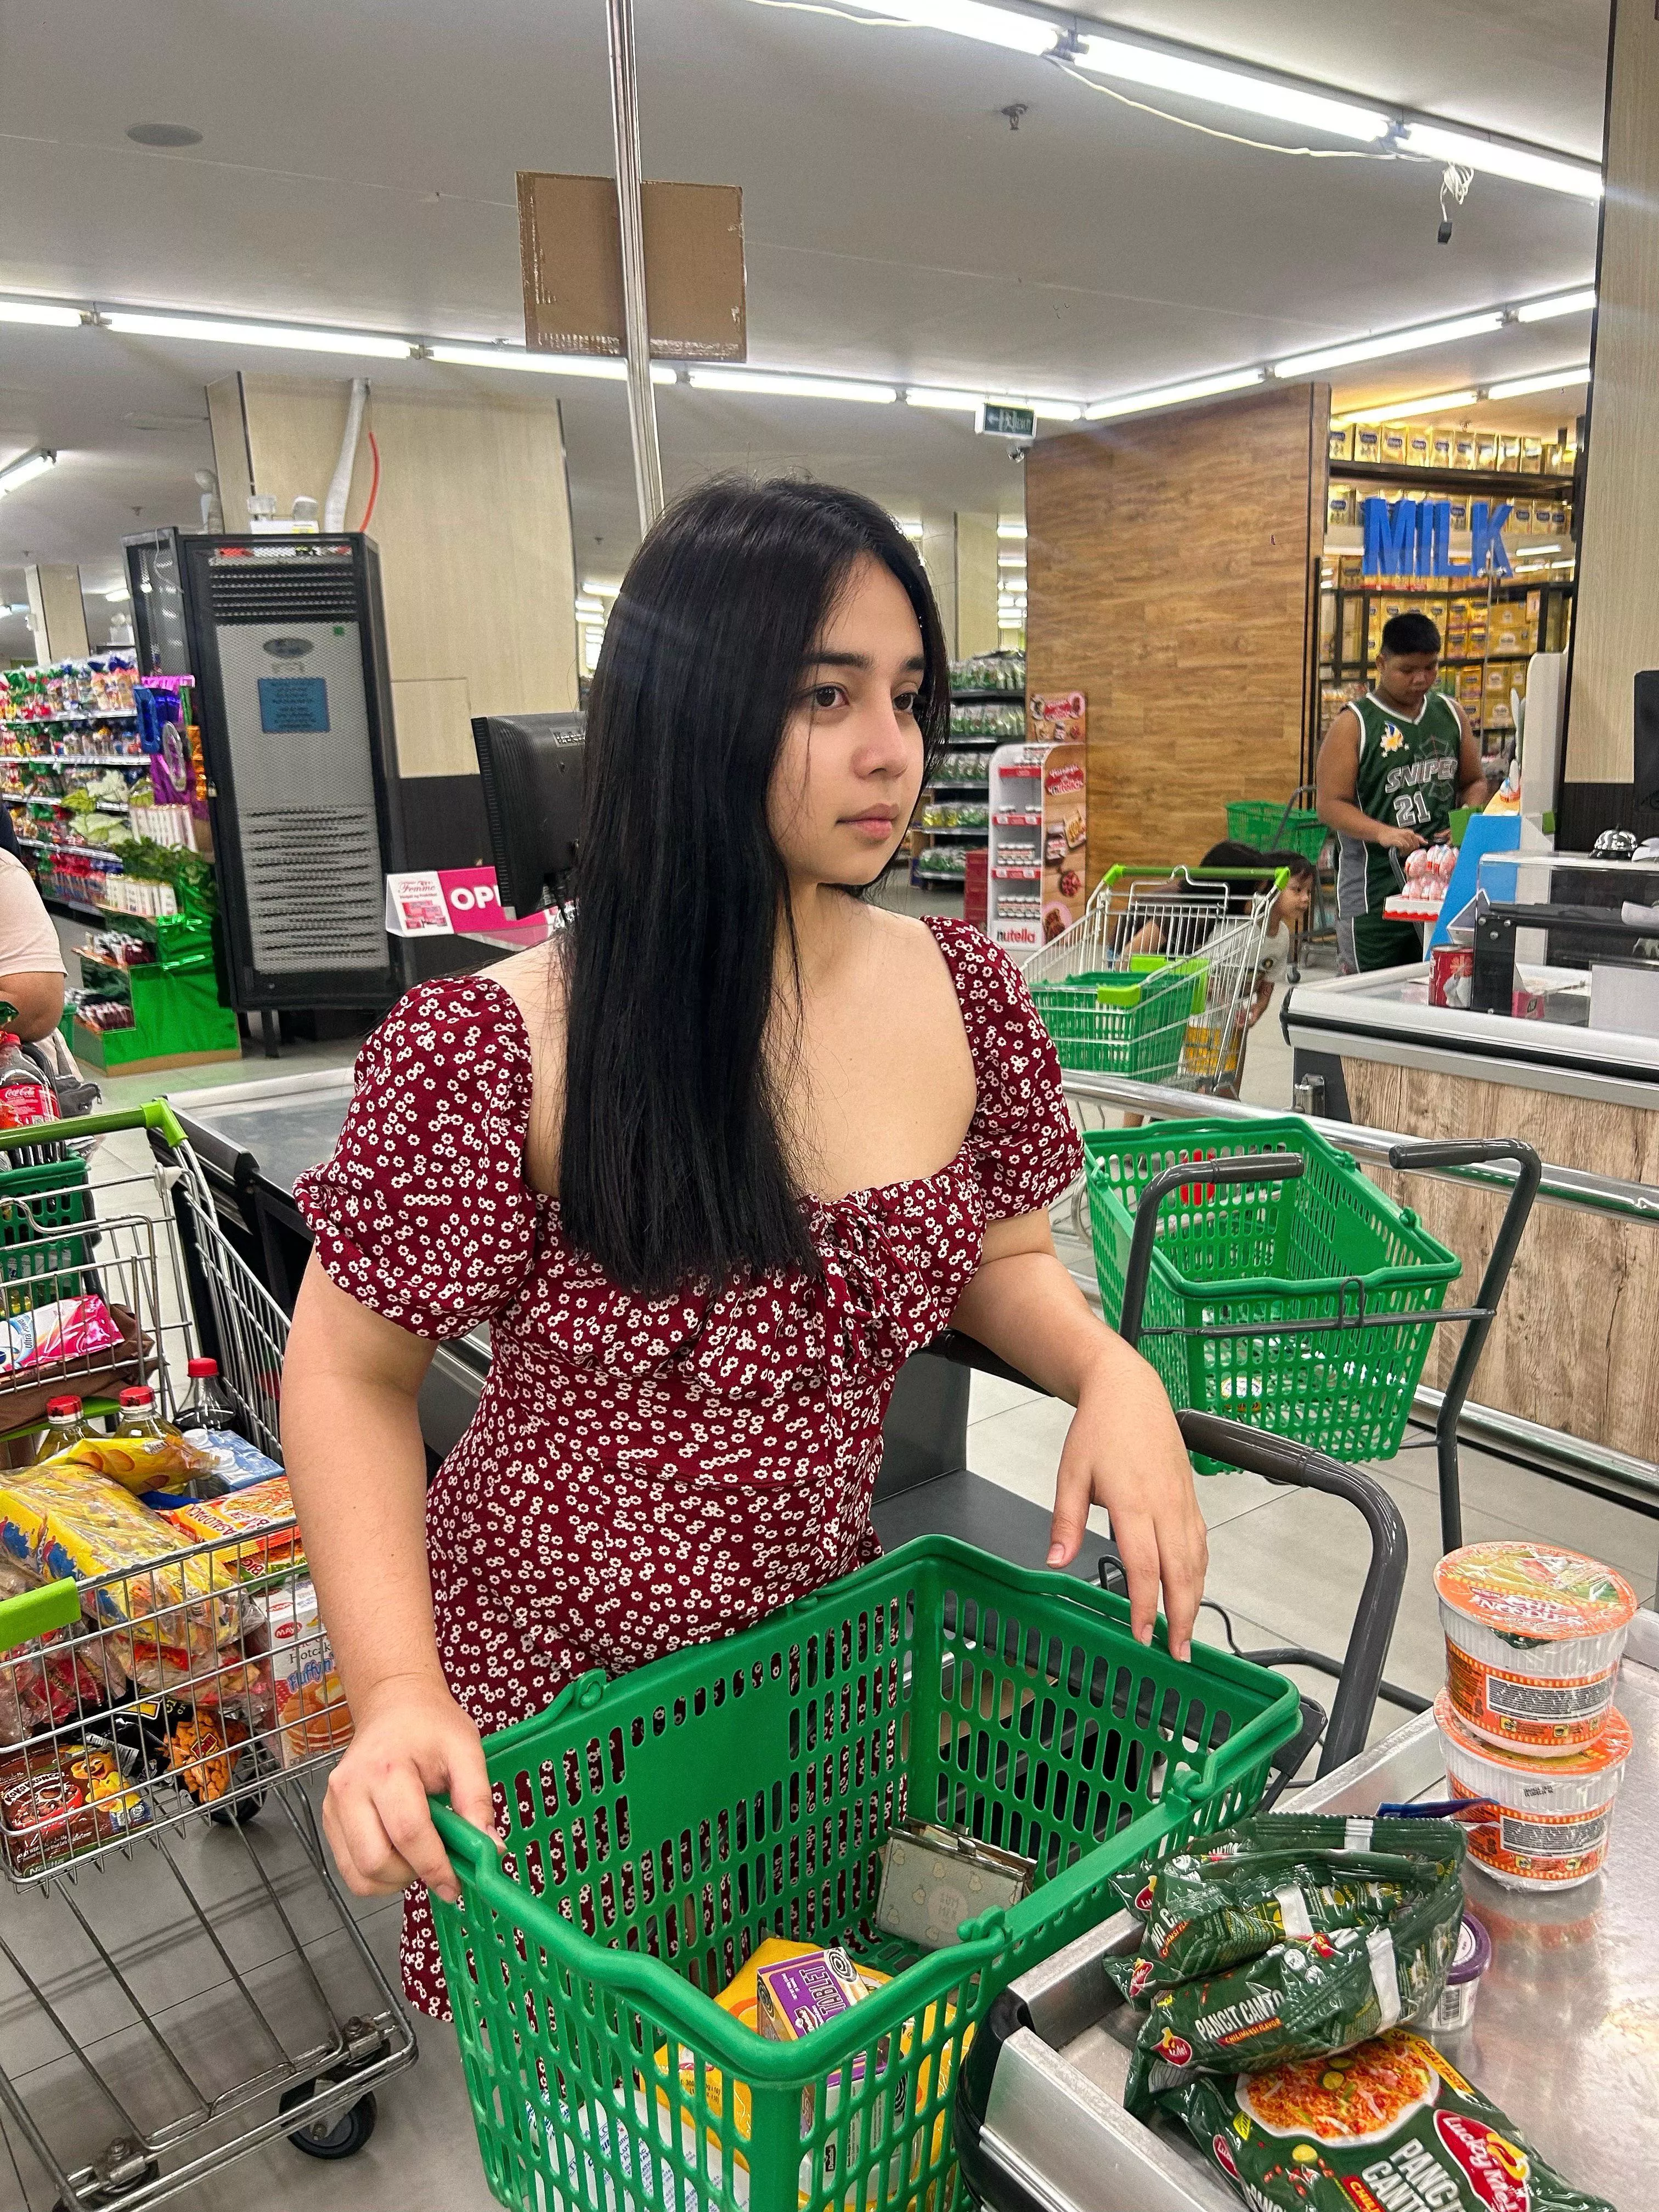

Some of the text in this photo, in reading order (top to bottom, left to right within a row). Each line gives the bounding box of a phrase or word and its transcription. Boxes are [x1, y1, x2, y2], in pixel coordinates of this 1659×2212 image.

[1363, 497, 1513, 578] MILK
[1393, 791, 1431, 828] 21
[997, 928, 1035, 943] nutella
[25, 1333, 33, 1348] Ultra
[241, 1558, 264, 1576] BIG
[289, 1641, 331, 1664] Hotcak
[5, 1786, 26, 1802] KOKO
[799, 1965, 846, 2016] TABLET
[1195, 1990, 1285, 2040] PANCIT CANTO
[1259, 2017, 1282, 2032] FLAVOR
[1415, 2040, 1445, 2066] GREAT
[1440, 2066, 1469, 2090] TASTE
[1442, 2117, 1493, 2168] Lucky
[1389, 2138, 1466, 2212] PANCI
[1350, 2181, 1383, 2212] CHIL
